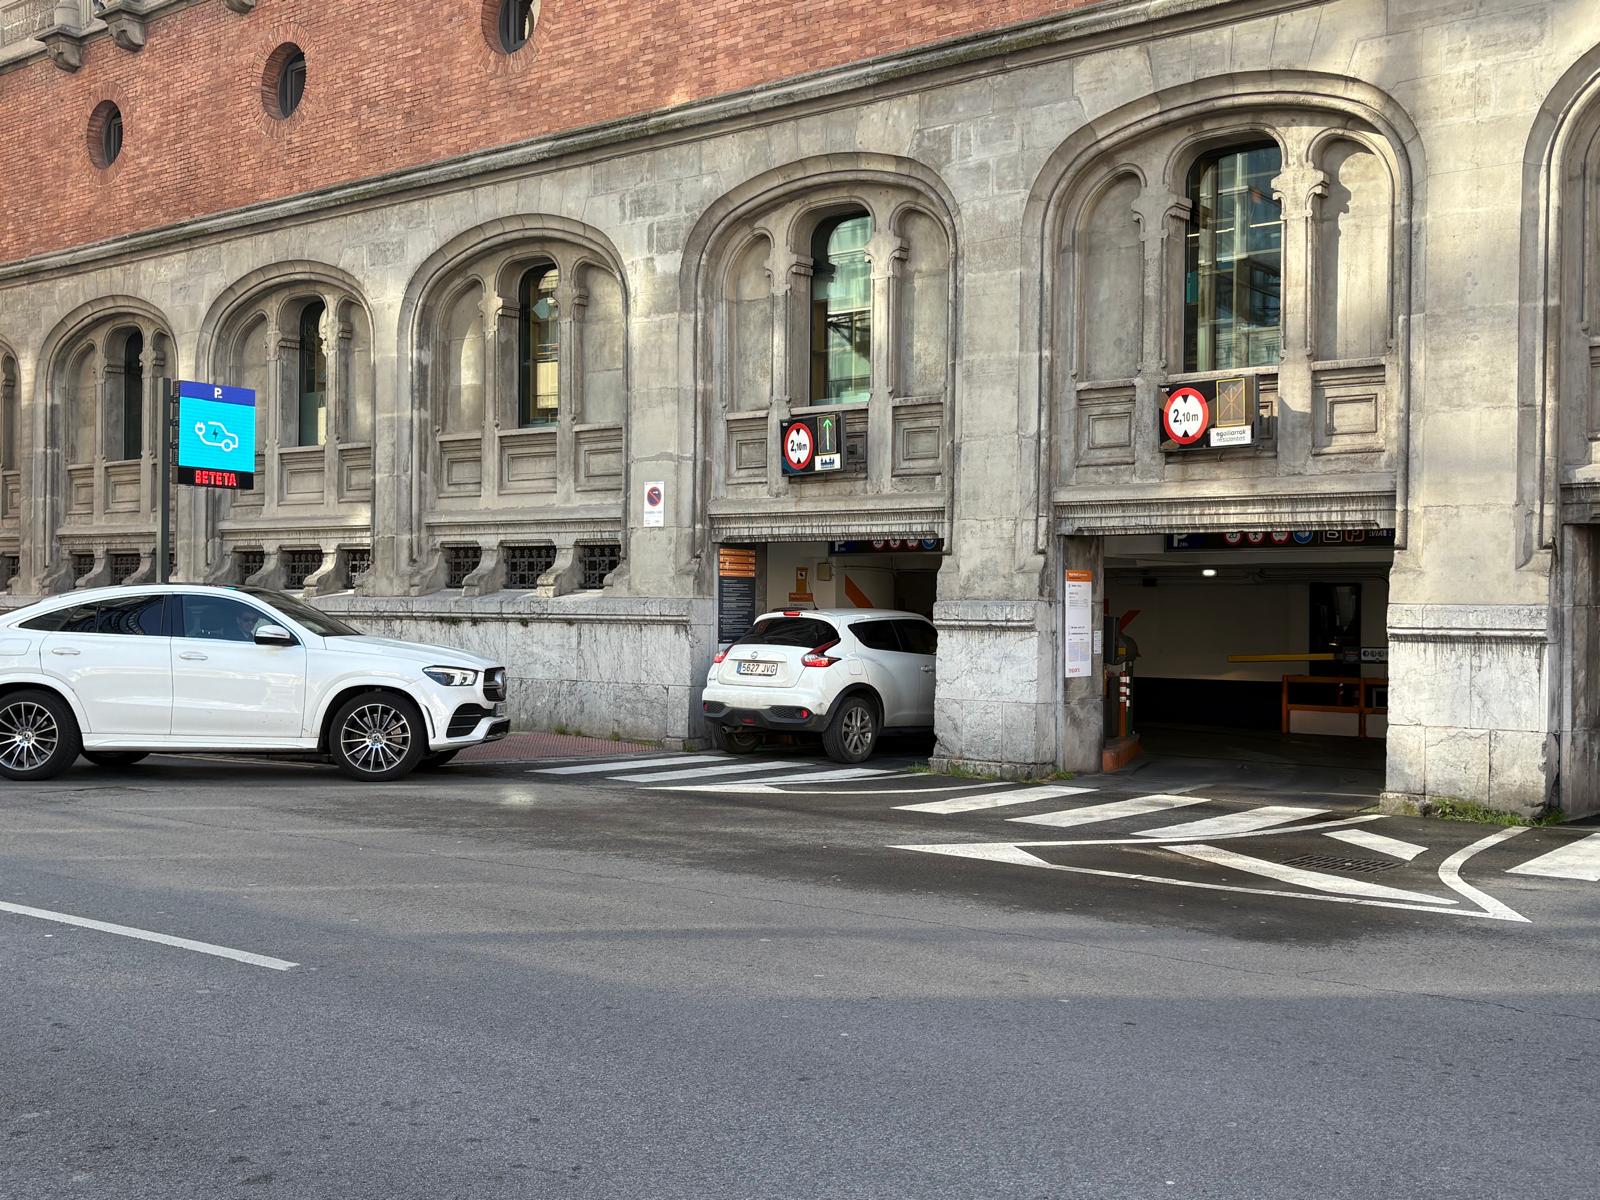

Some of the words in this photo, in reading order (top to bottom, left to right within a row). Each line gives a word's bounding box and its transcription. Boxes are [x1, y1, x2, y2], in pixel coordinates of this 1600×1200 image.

[195, 470, 237, 486] BETETA
[742, 663, 760, 673] 5627
[761, 664, 776, 673] JVG
